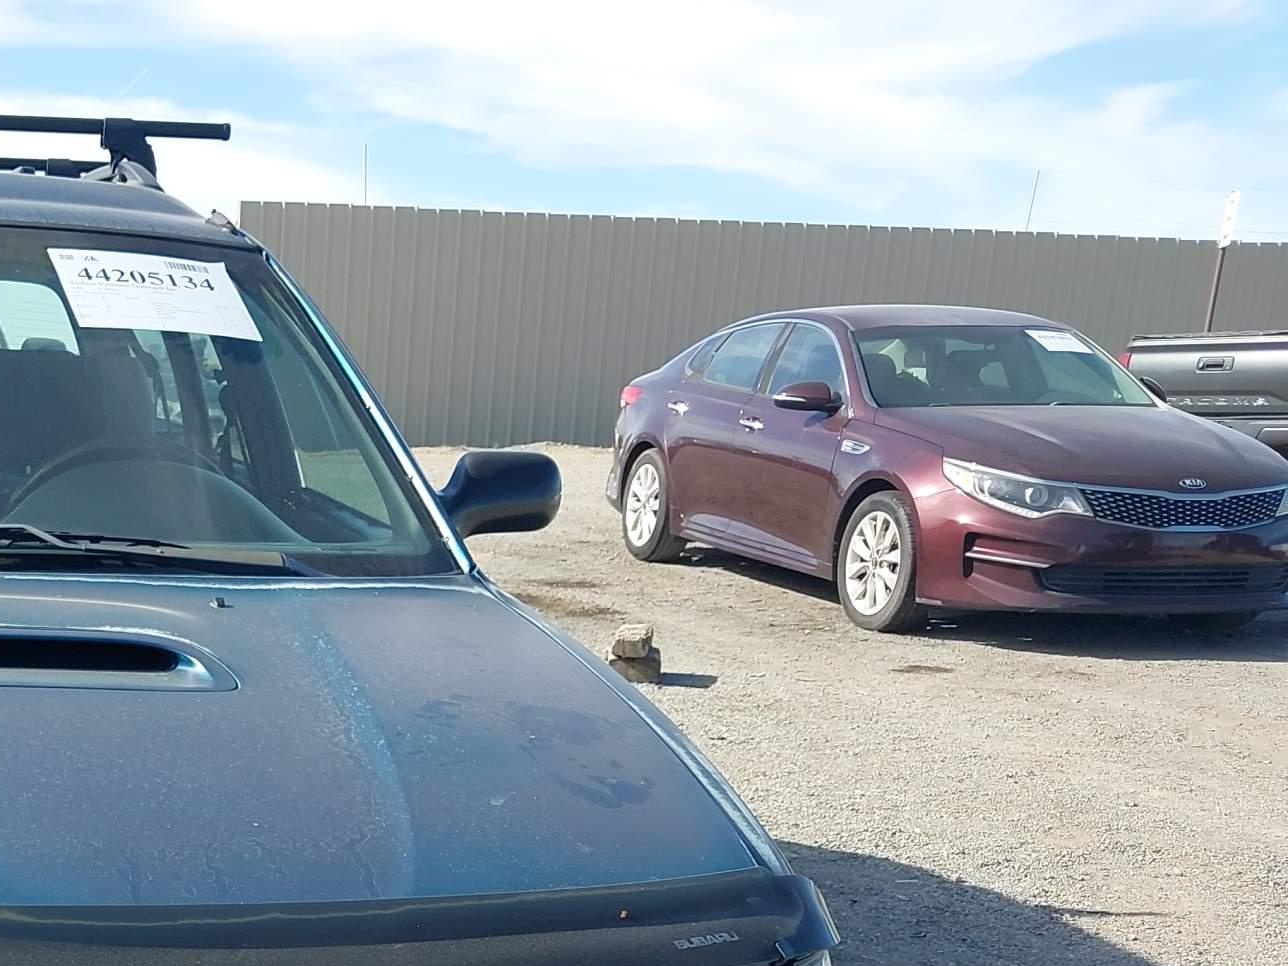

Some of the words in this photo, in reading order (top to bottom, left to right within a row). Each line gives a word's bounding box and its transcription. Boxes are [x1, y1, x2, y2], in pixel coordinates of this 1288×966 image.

[78, 267, 215, 291] 44205134
[1166, 397, 1270, 406] TACOMA
[1182, 478, 1204, 487] KIA
[672, 931, 740, 950] SUBARU
